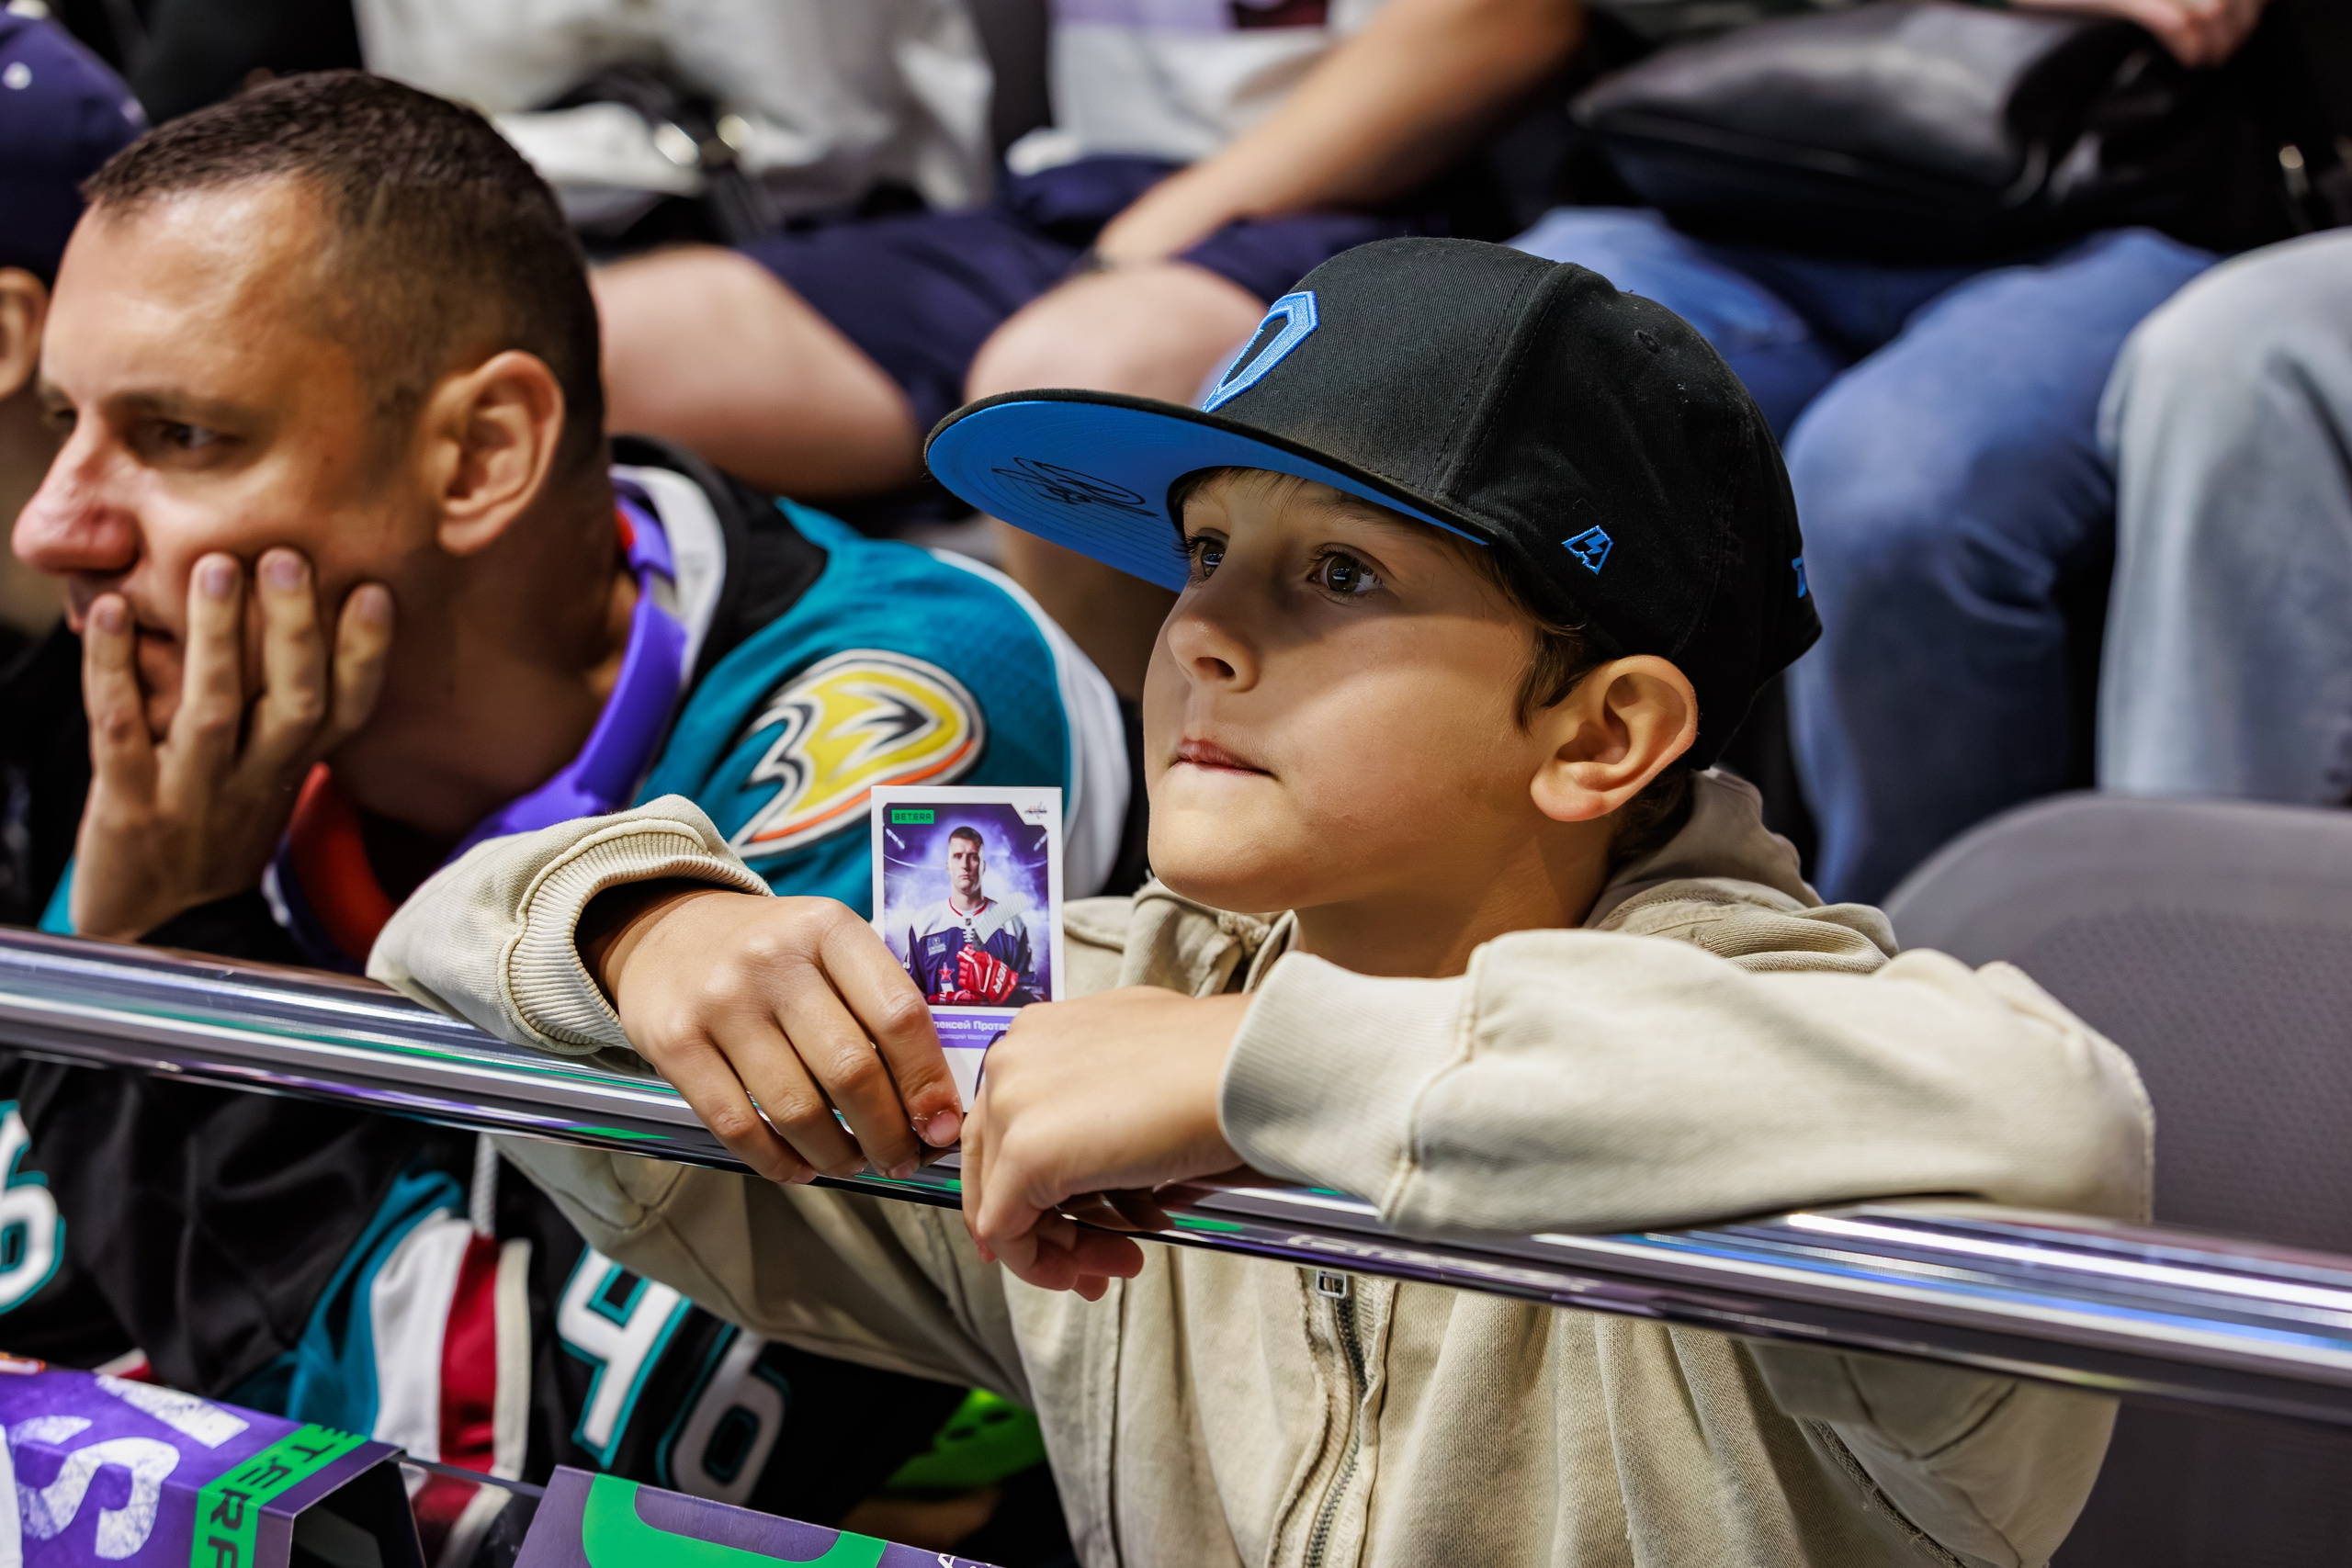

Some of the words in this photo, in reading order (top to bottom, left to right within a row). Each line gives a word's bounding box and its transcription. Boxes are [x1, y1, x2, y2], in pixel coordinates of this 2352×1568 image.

[894, 812, 932, 821] BETERA
[933, 1020, 971, 1030] лексей
[973, 1021, 1011, 1032] Протас
[207, 1433, 347, 1568] TERA
